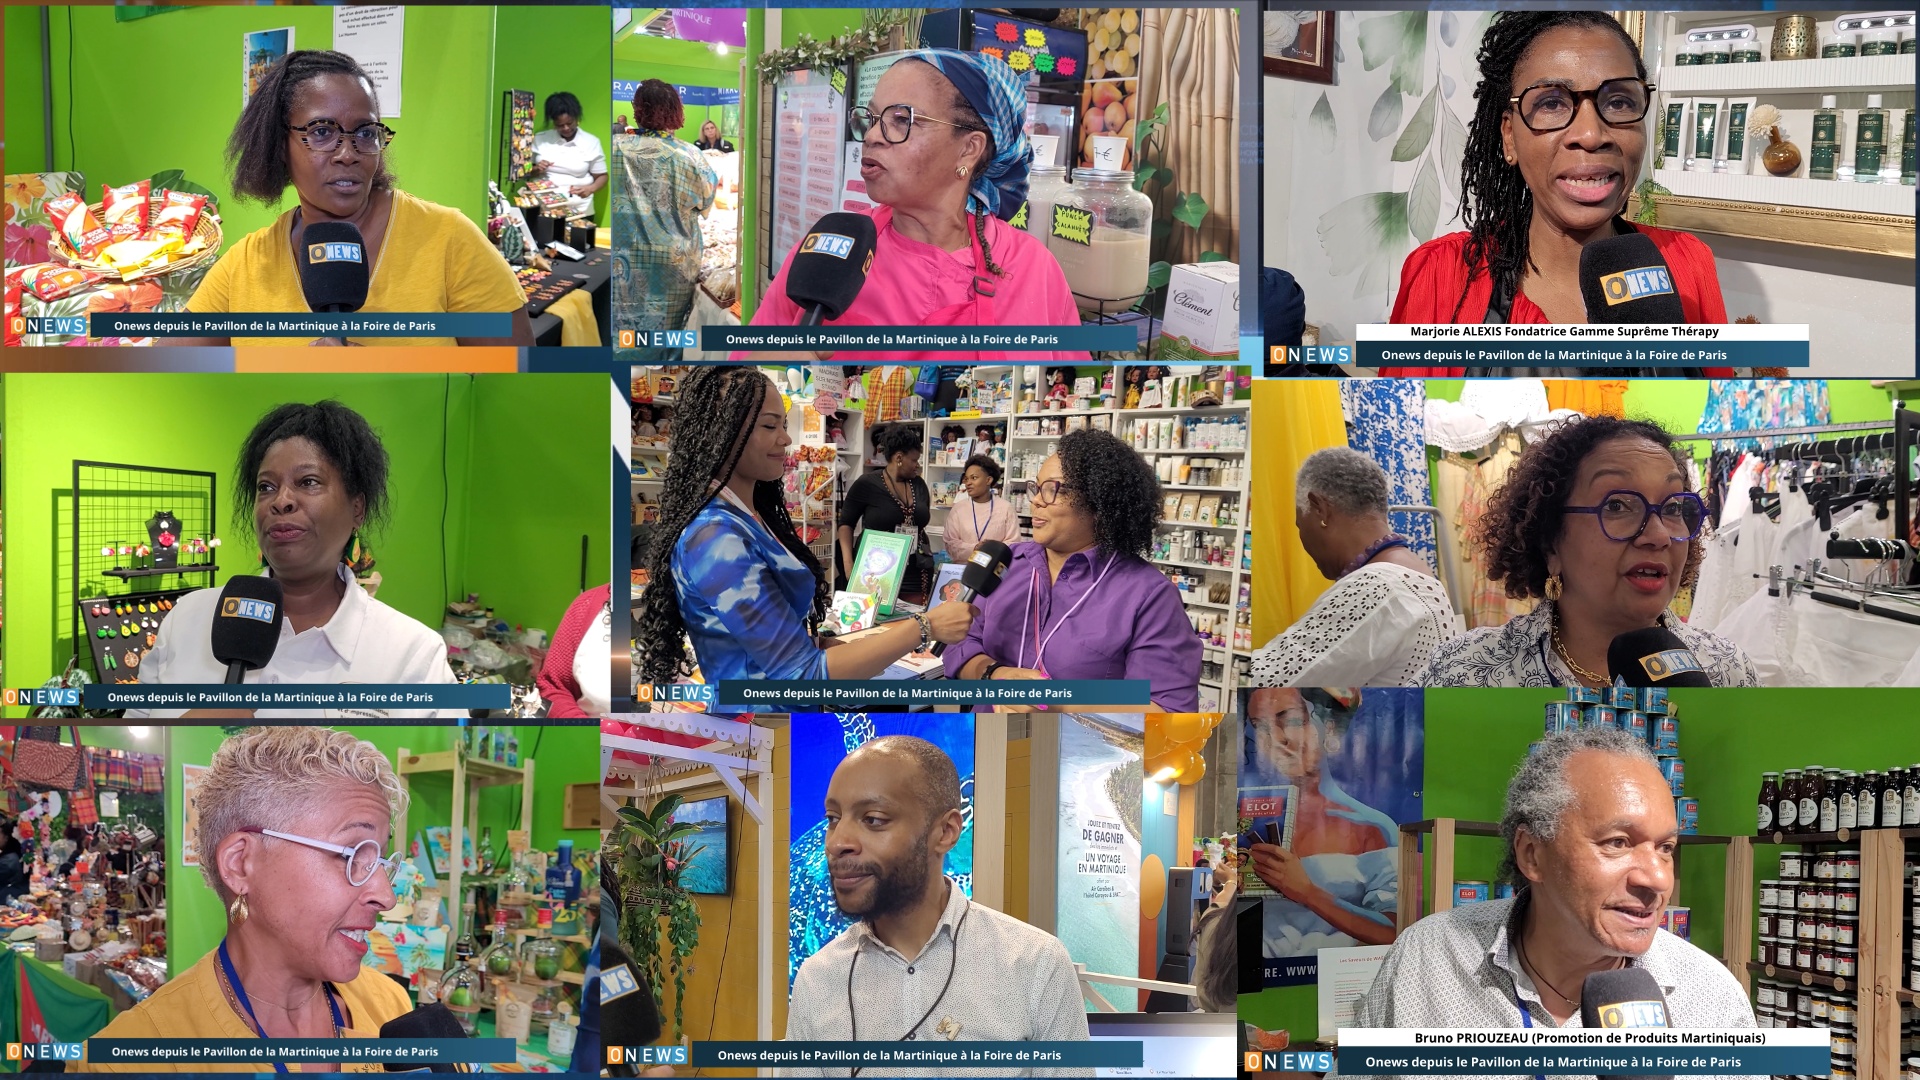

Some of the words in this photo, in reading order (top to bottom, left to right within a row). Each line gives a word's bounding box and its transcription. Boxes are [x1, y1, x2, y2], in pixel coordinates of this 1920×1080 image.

[1061, 210, 1084, 221] PUNCH
[311, 244, 360, 261] ONEWS
[804, 234, 851, 255] ONEWS
[1606, 269, 1669, 300] ONEWS
[1173, 289, 1213, 317] Clément
[225, 599, 273, 620] ONEWS
[1246, 803, 1277, 812] ELOT
[1082, 829, 1092, 841] DE
[1094, 830, 1124, 844] GAGNER
[1085, 852, 1096, 863] UN
[1097, 853, 1121, 864] VOYAGE
[1078, 863, 1088, 873] EN
[1089, 863, 1127, 874] MARTINIQUE
